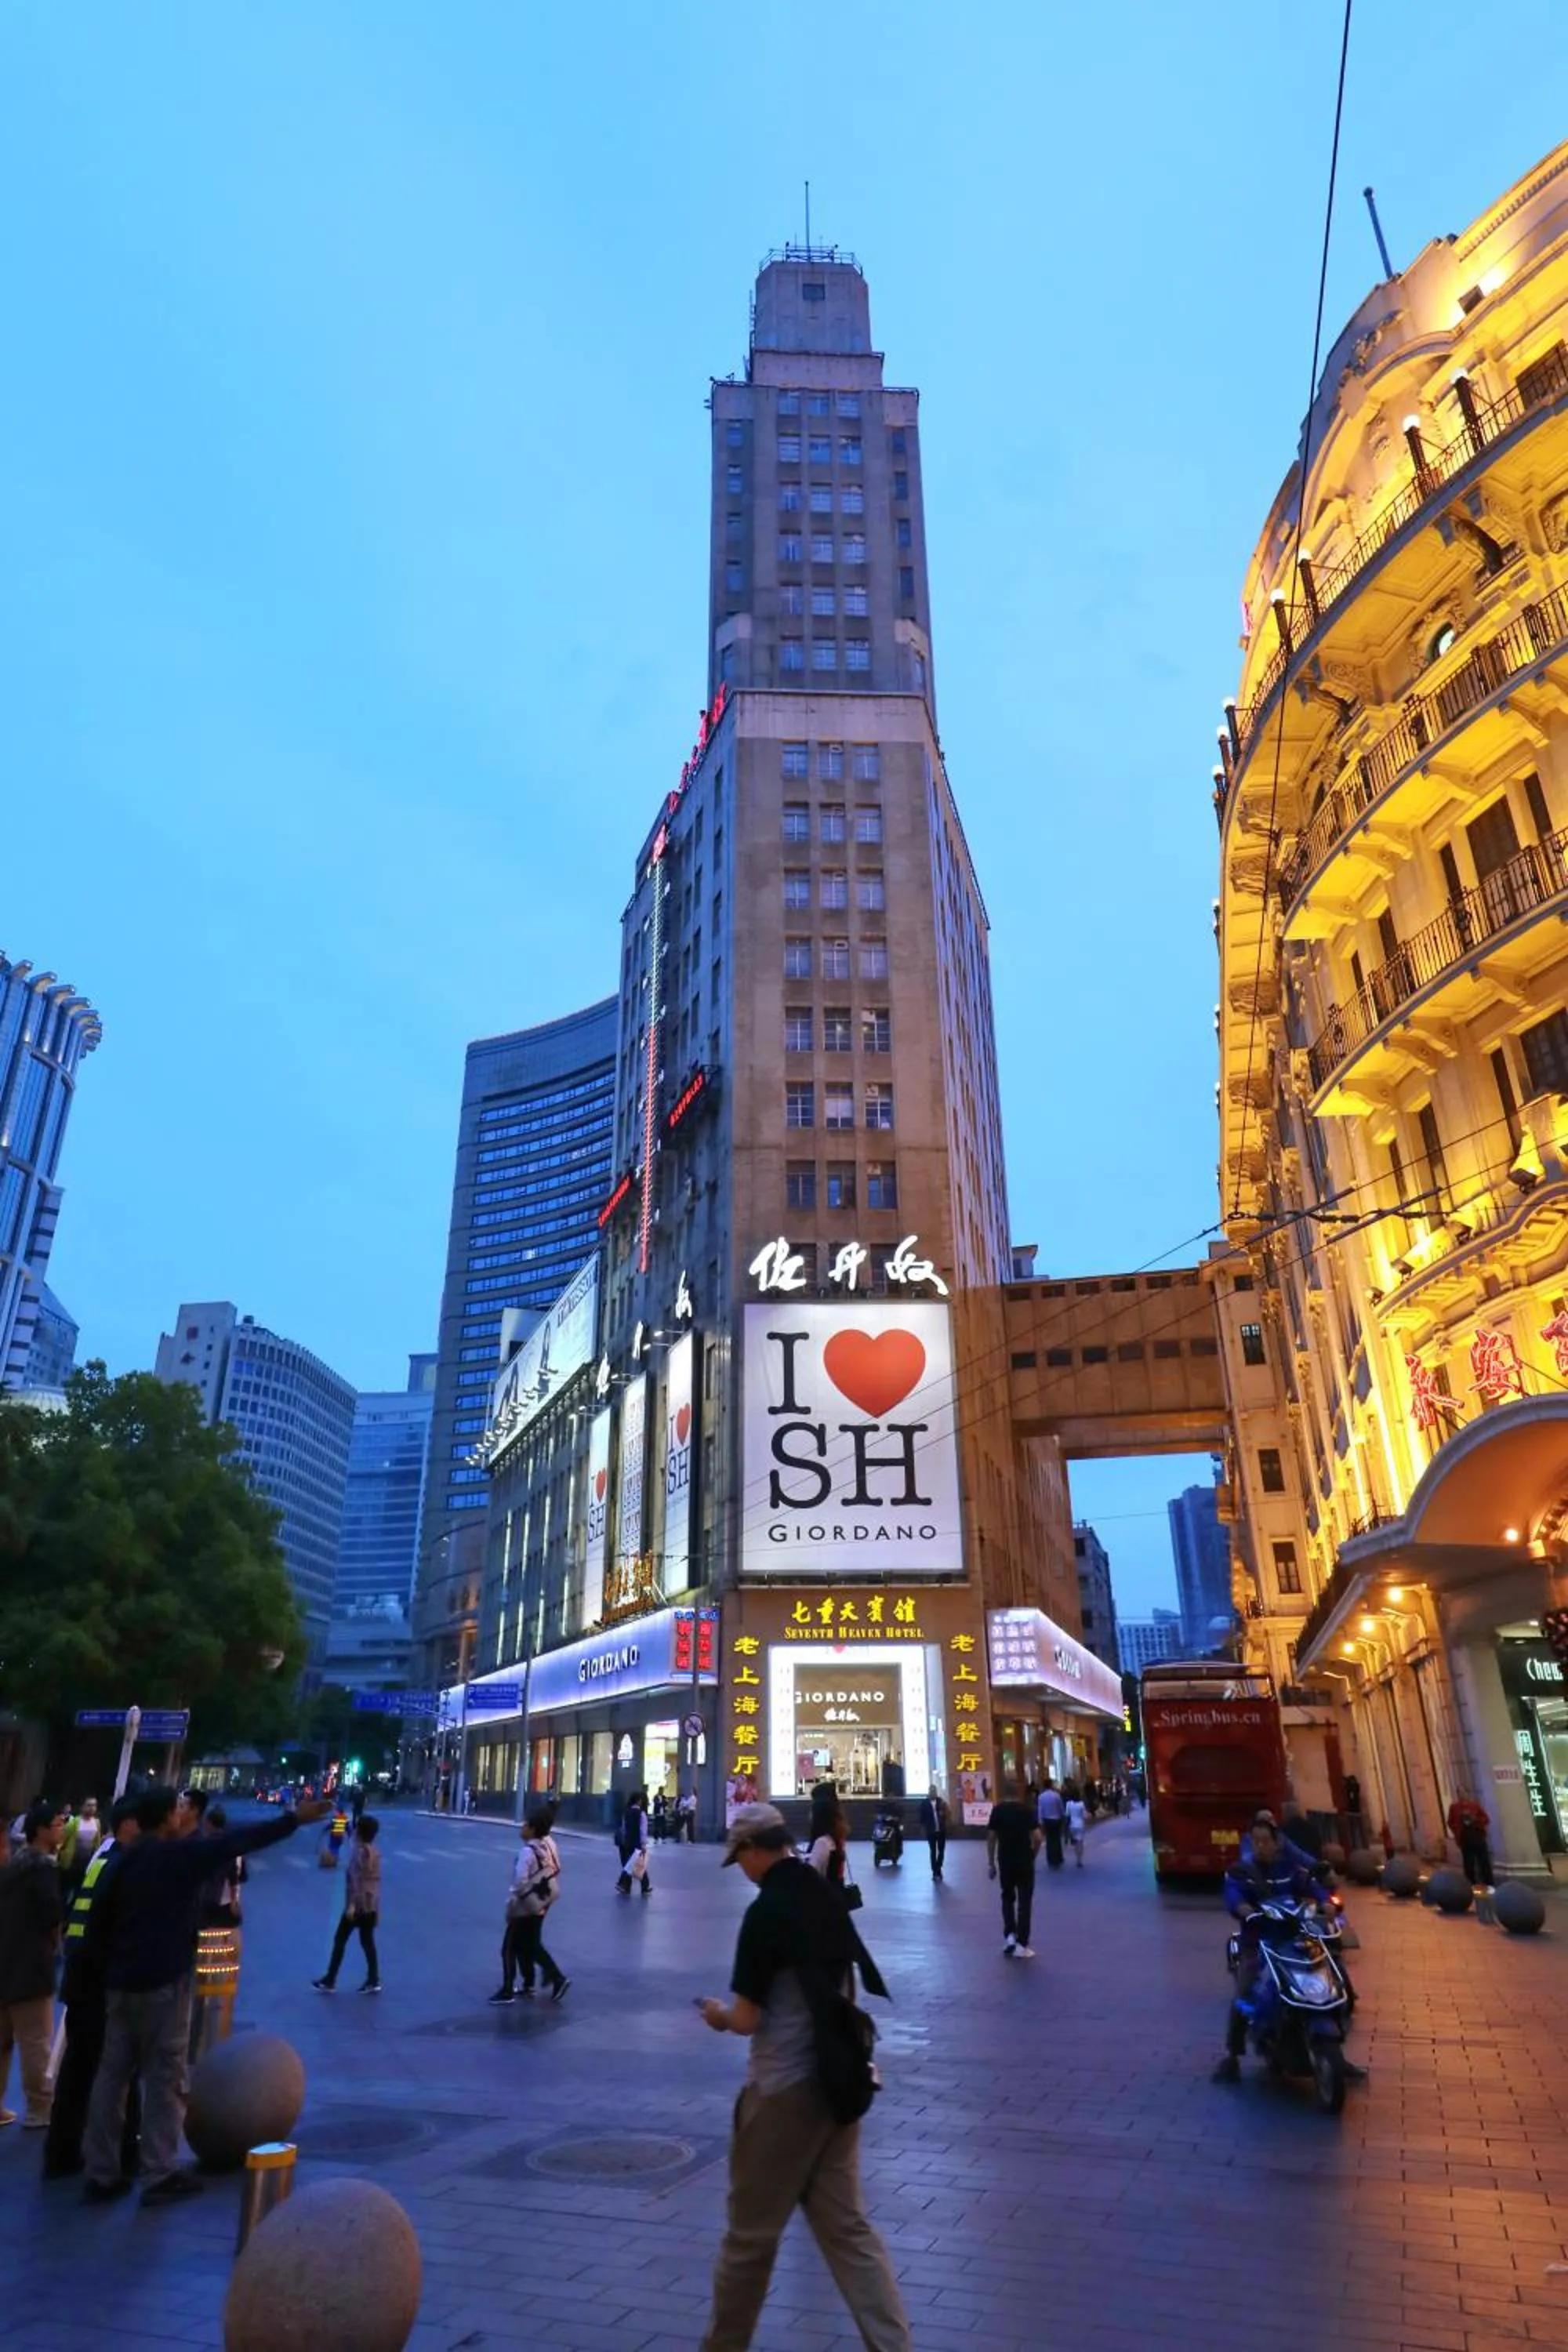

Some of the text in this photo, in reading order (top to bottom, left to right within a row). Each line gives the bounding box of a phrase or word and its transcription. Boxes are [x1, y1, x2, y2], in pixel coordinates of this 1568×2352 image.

[749, 1236, 948, 1295] 佐丹奴
[767, 1331, 811, 1415] I
[667, 1446, 691, 1494] SH
[769, 1421, 933, 1509] SH
[768, 1524, 937, 1543] GIORDANO
[792, 1595, 916, 1624] 七重天賓館
[579, 1645, 638, 1682] GIORDANO
[733, 1636, 760, 1775] 老上海餐厅
[950, 1634, 982, 1772] 老上海餐厅
